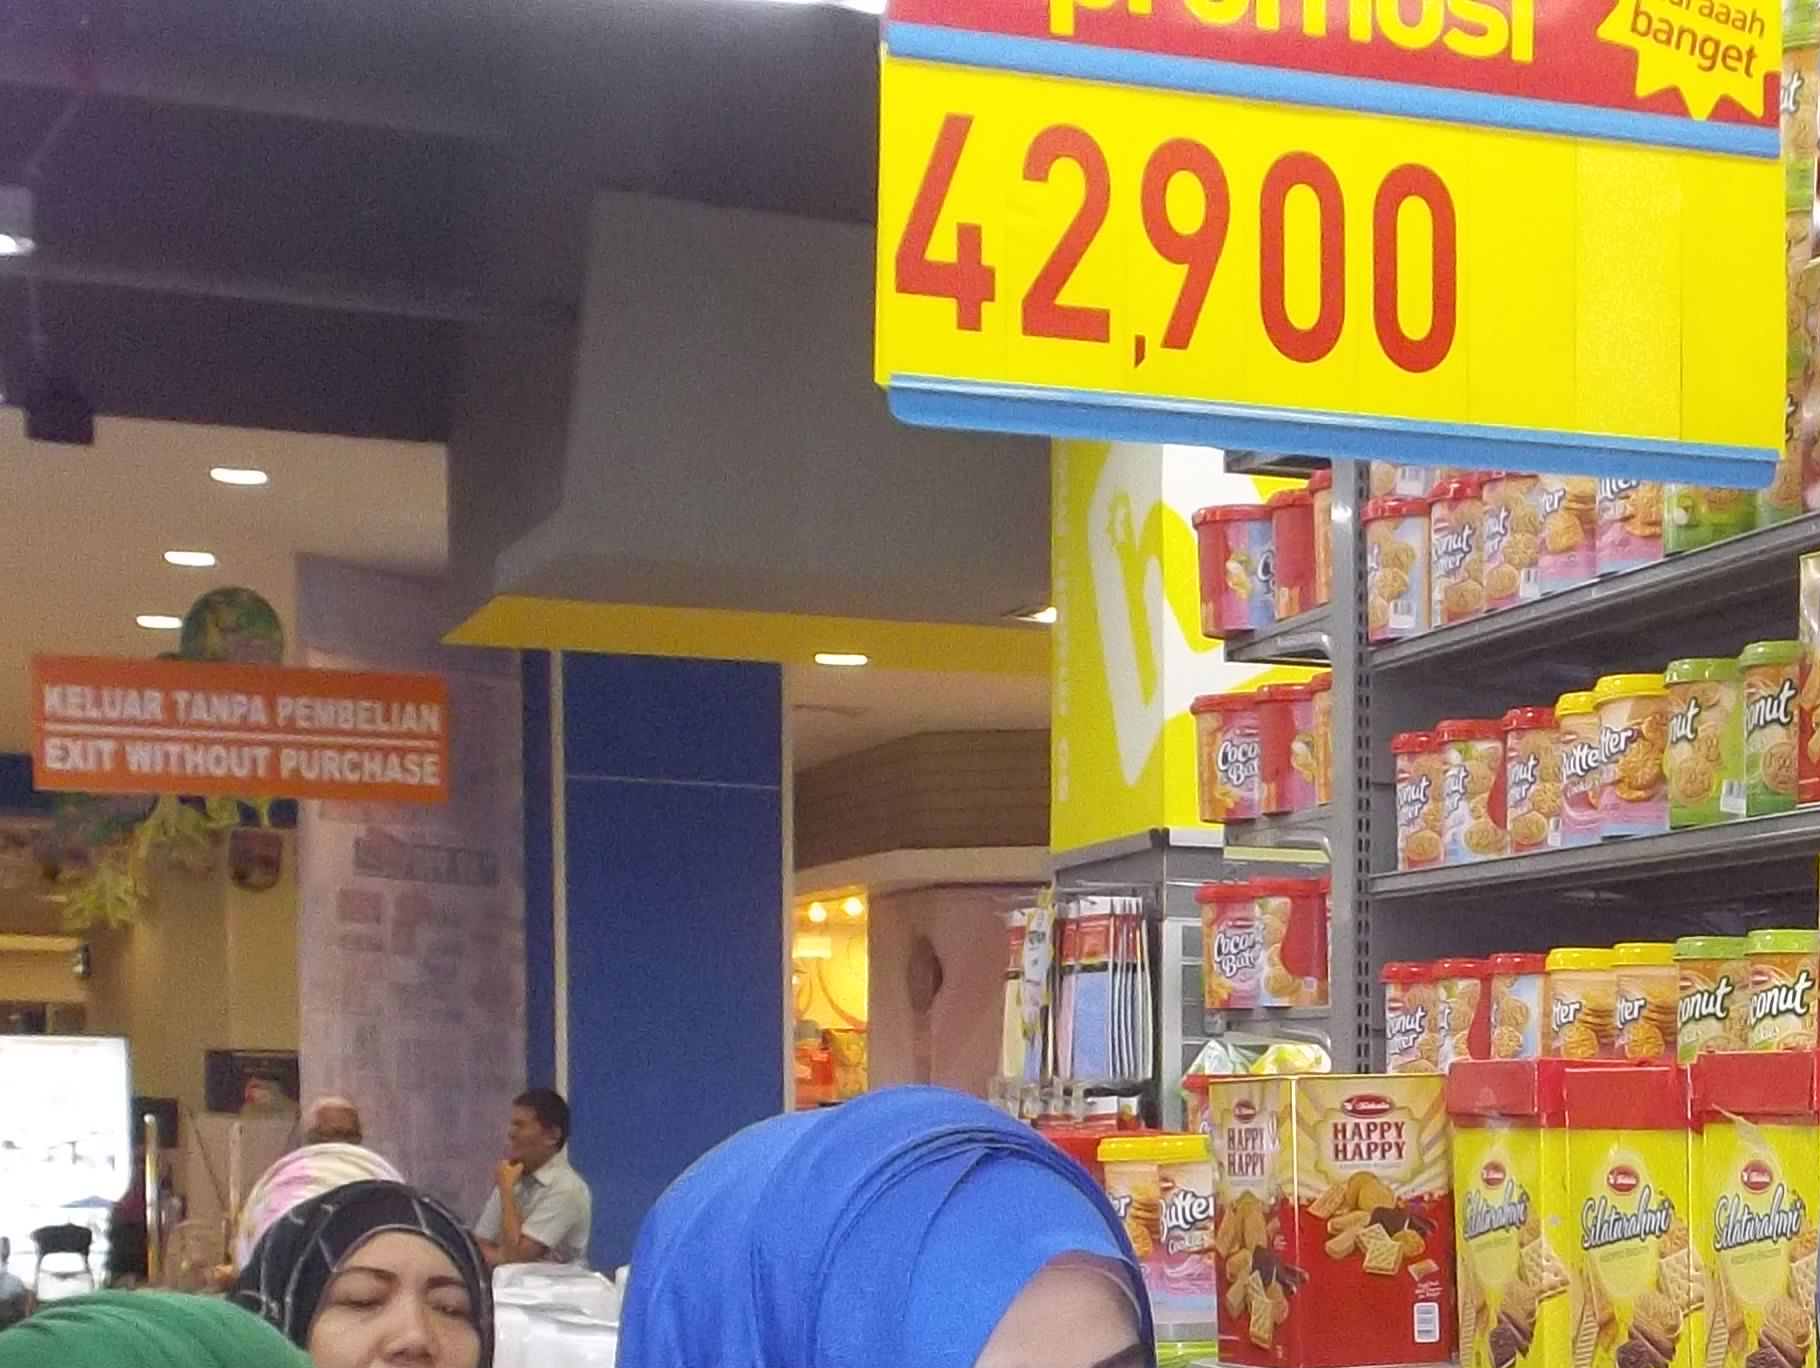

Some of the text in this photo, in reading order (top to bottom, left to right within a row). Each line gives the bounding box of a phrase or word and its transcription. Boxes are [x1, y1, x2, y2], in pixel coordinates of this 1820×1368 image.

[1630, 0, 1759, 78] banget
[894, 113, 1457, 374] 42,900
[45, 685, 439, 732] KELUAR TANPA PEMBELIAN
[44, 738, 440, 786] EXIT WITHOUT PURCHASE
[1750, 971, 1815, 1025] conut
[1227, 1126, 1265, 1150] HAPPY
[1333, 1121, 1406, 1140] HAPPY
[1334, 1142, 1406, 1161] HAPPY
[1227, 1152, 1265, 1177] HAPPY
[1463, 1180, 1529, 1241] Silaturahmi
[1580, 1185, 1674, 1250] Silaturahmi
[1713, 1185, 1805, 1252] Silaturahmi
